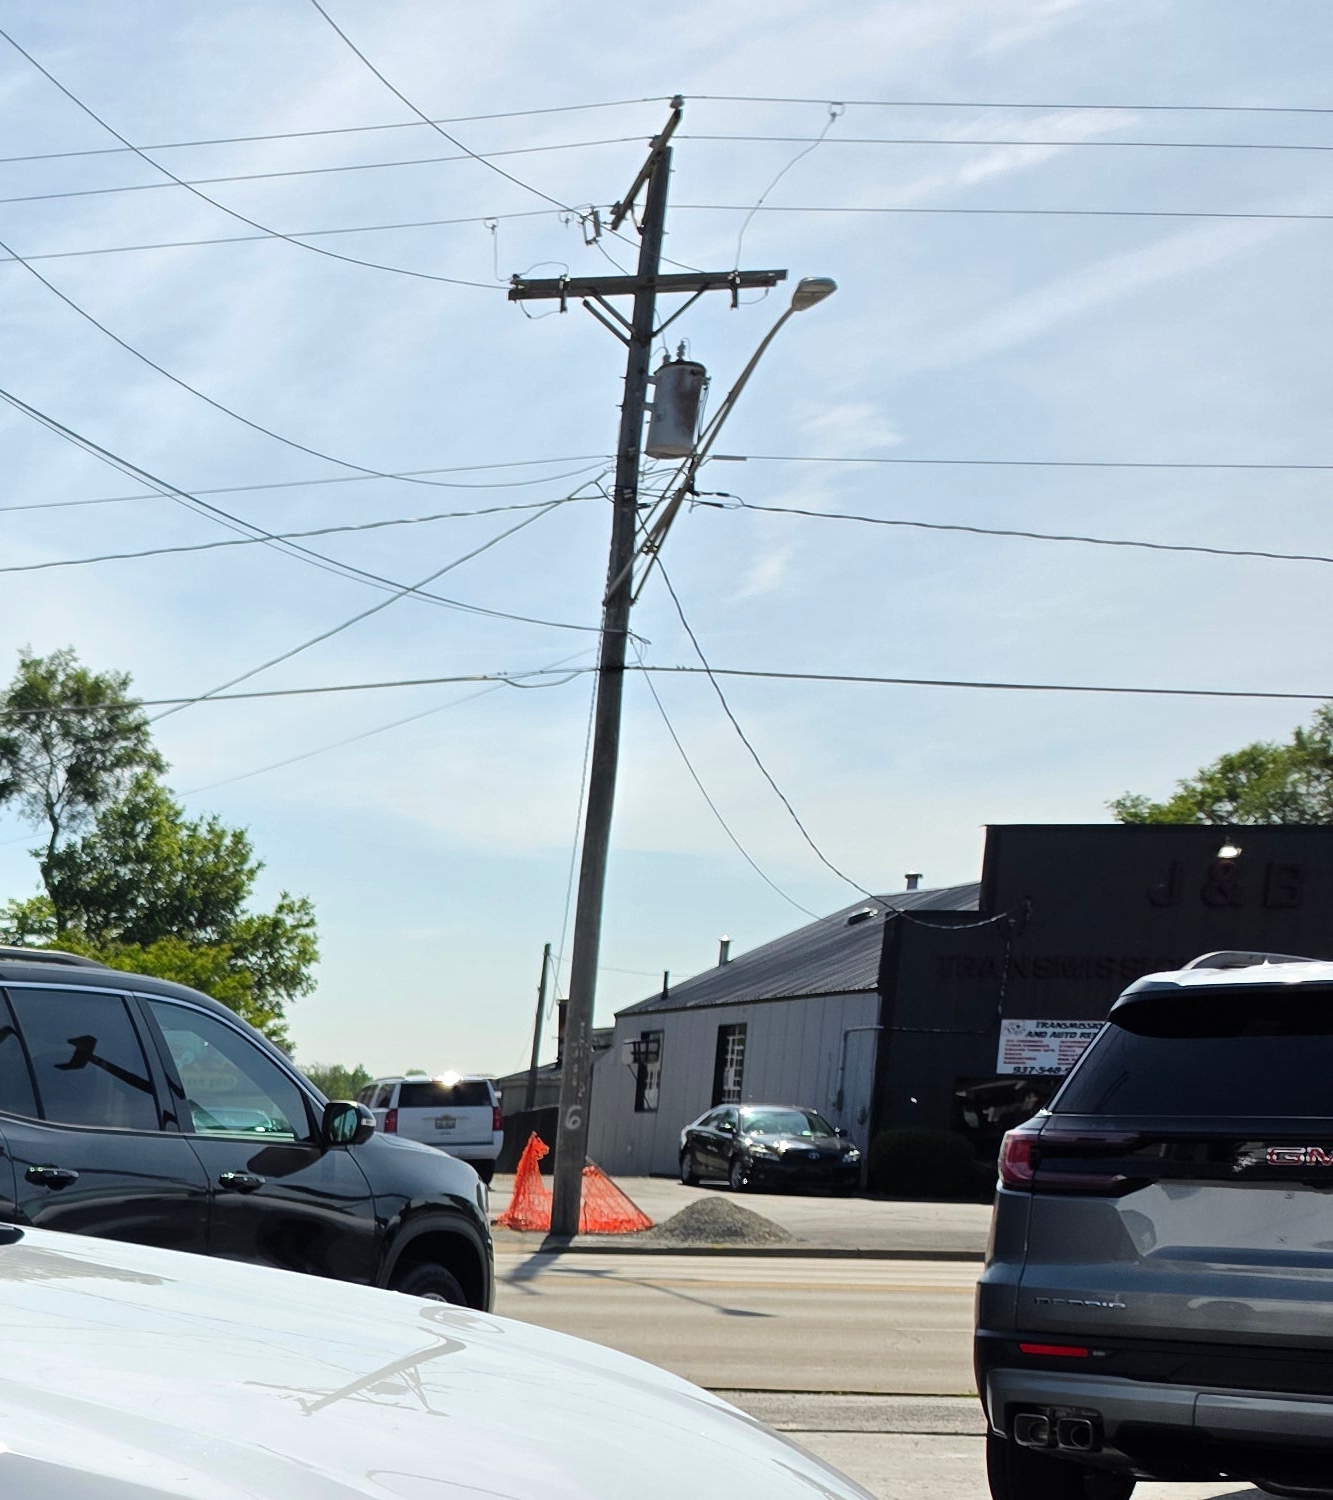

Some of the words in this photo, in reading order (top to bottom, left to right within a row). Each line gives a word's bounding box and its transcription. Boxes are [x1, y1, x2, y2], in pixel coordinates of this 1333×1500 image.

[1146, 859, 1184, 909] J
[1200, 862, 1247, 909] &
[935, 955, 1188, 980] TRANSMISSIO
[1025, 1031, 1048, 1039] AND
[1050, 1031, 1078, 1039] AUTO
[564, 1104, 583, 1130] 6
